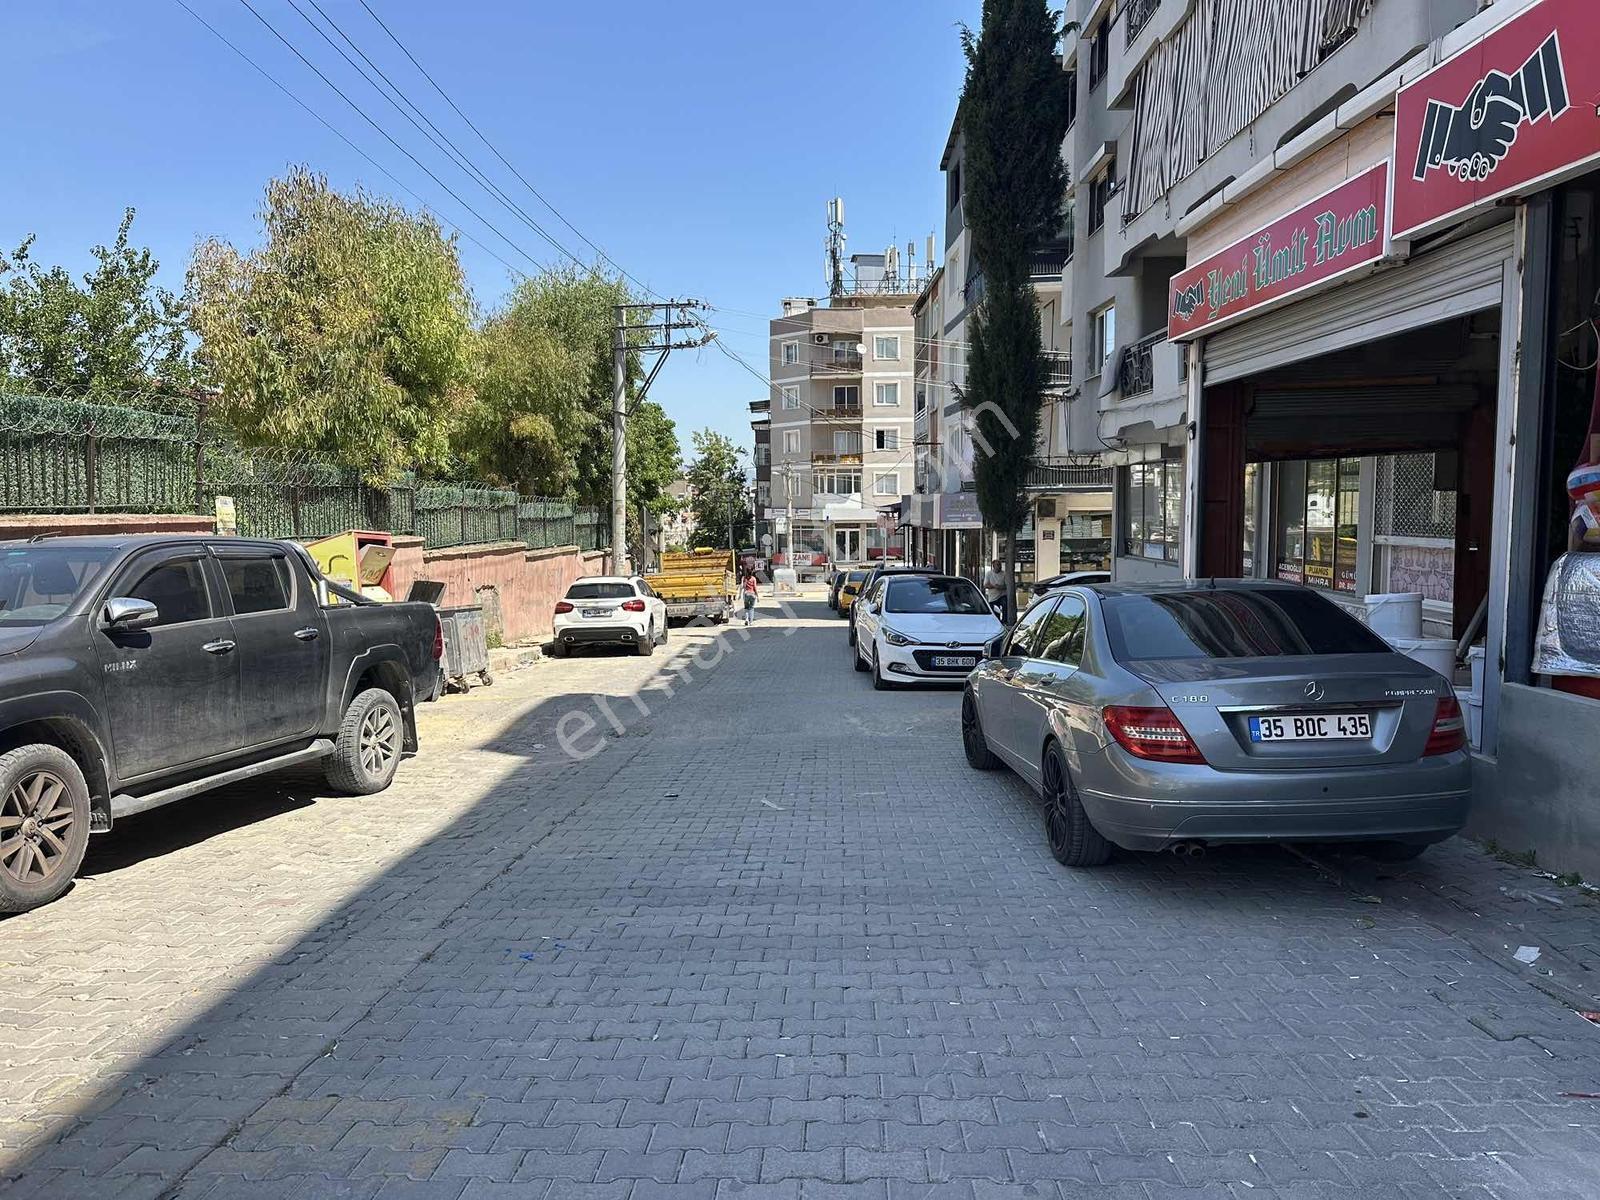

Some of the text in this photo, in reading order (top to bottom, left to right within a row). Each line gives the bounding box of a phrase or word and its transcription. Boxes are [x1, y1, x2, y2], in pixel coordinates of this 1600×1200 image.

[1207, 204, 1378, 320] Yeni Ümit Avm
[1260, 718, 1284, 738] 35
[1293, 717, 1328, 737] BOC
[1337, 716, 1370, 736] 435
